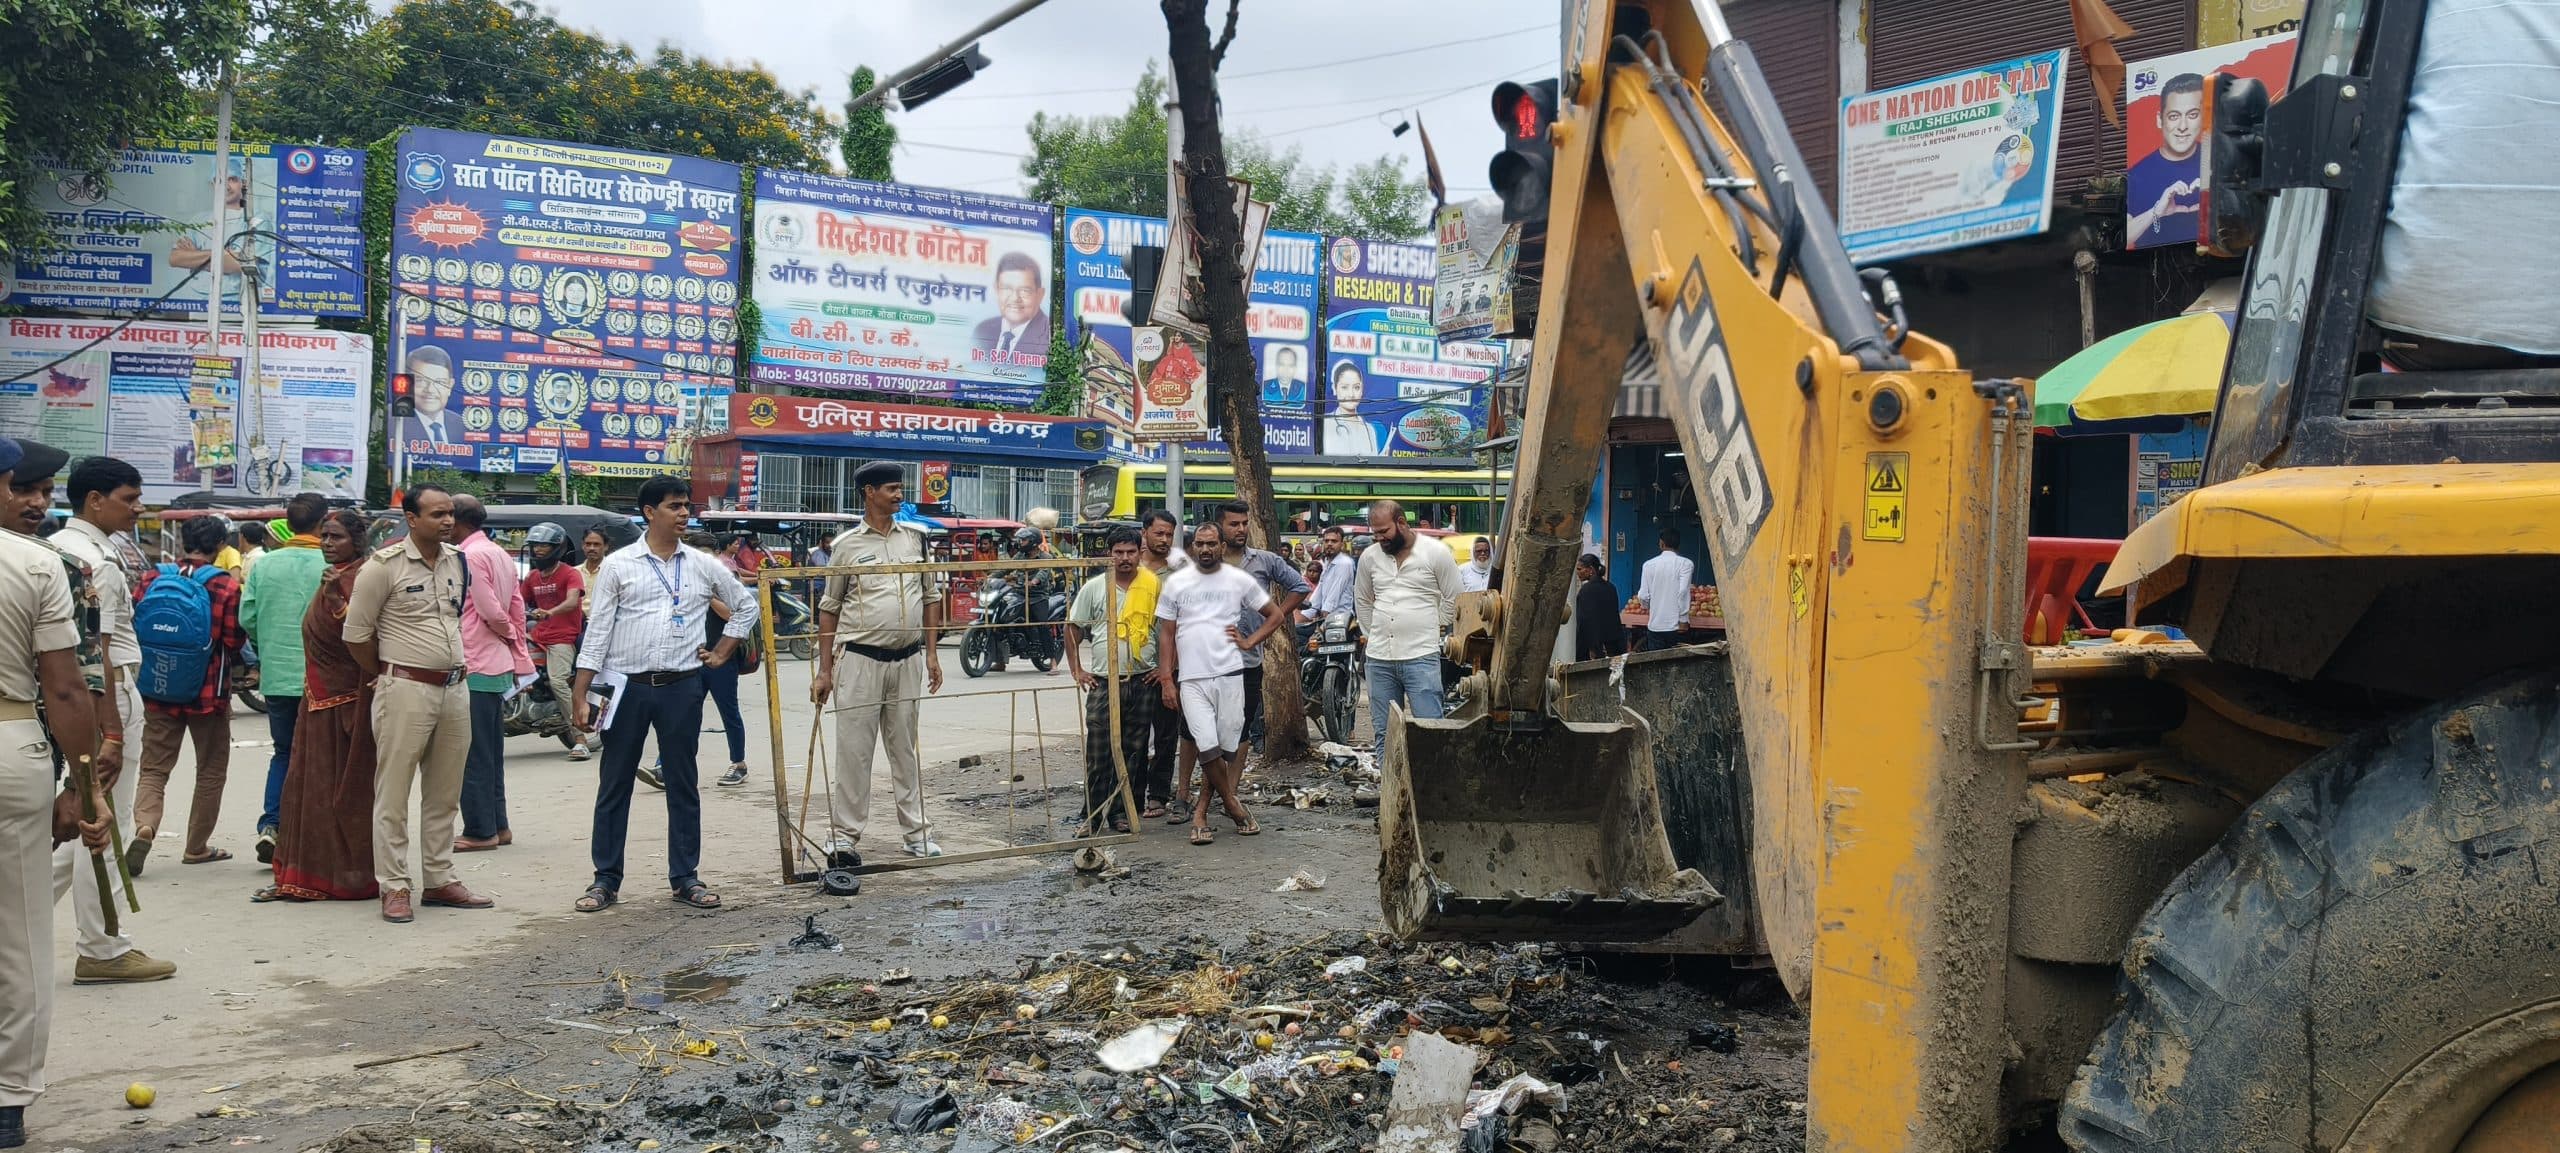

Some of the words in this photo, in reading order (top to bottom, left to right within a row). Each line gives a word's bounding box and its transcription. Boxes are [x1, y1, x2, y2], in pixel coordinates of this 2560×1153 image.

[1846, 100, 1881, 128] ONE
[1886, 84, 1957, 121] NATION
[1961, 74, 2001, 105] ONE
[2007, 62, 2052, 95] TAX
[1895, 120, 1923, 136] (RAJ
[1925, 106, 1991, 129] SHEKHAR)
[323, 154, 354, 166] ISO
[451, 158, 487, 188] संत
[492, 161, 536, 194] पॉल
[539, 165, 613, 201] सिनियर
[689, 187, 737, 220] स्कूल
[816, 210, 907, 257] सिद्धेश्वर
[915, 225, 989, 266] कॉलेज
[1108, 218, 1142, 256] MAA
[1441, 243, 1455, 255] THE
[768, 258, 818, 286] ऑफ
[827, 262, 888, 293] टीचर्स
[895, 272, 988, 305] एजुकेशन
[1078, 261, 1104, 278] Civil
[1334, 275, 1401, 304] RESEARCH
[1403, 282, 1415, 305] &
[9, 318, 64, 338] बिहार
[118, 327, 181, 344] आपदा
[1265, 308, 1304, 330] Course
[498, 363, 527, 371] STREAM
[761, 344, 824, 363] नामांकन
[828, 349, 843, 365] के
[847, 349, 874, 368] लिए
[971, 347, 988, 362] Dr.
[990, 348, 1011, 364] S.P.
[1012, 350, 1048, 368] Verma
[757, 365, 792, 381] Mob:-
[794, 368, 873, 389] 9431058785,
[795, 401, 874, 429] पुलिस
[879, 410, 981, 434] सहायता
[988, 413, 1053, 438] केन्द्र
[1143, 408, 1174, 420] अजमेरा
[1263, 423, 1311, 450] Hospital
[1668, 303, 1765, 556] JCB
[436, 440, 474, 457] Verma
[152, 622, 179, 633] safari
[151, 651, 170, 696] safari
